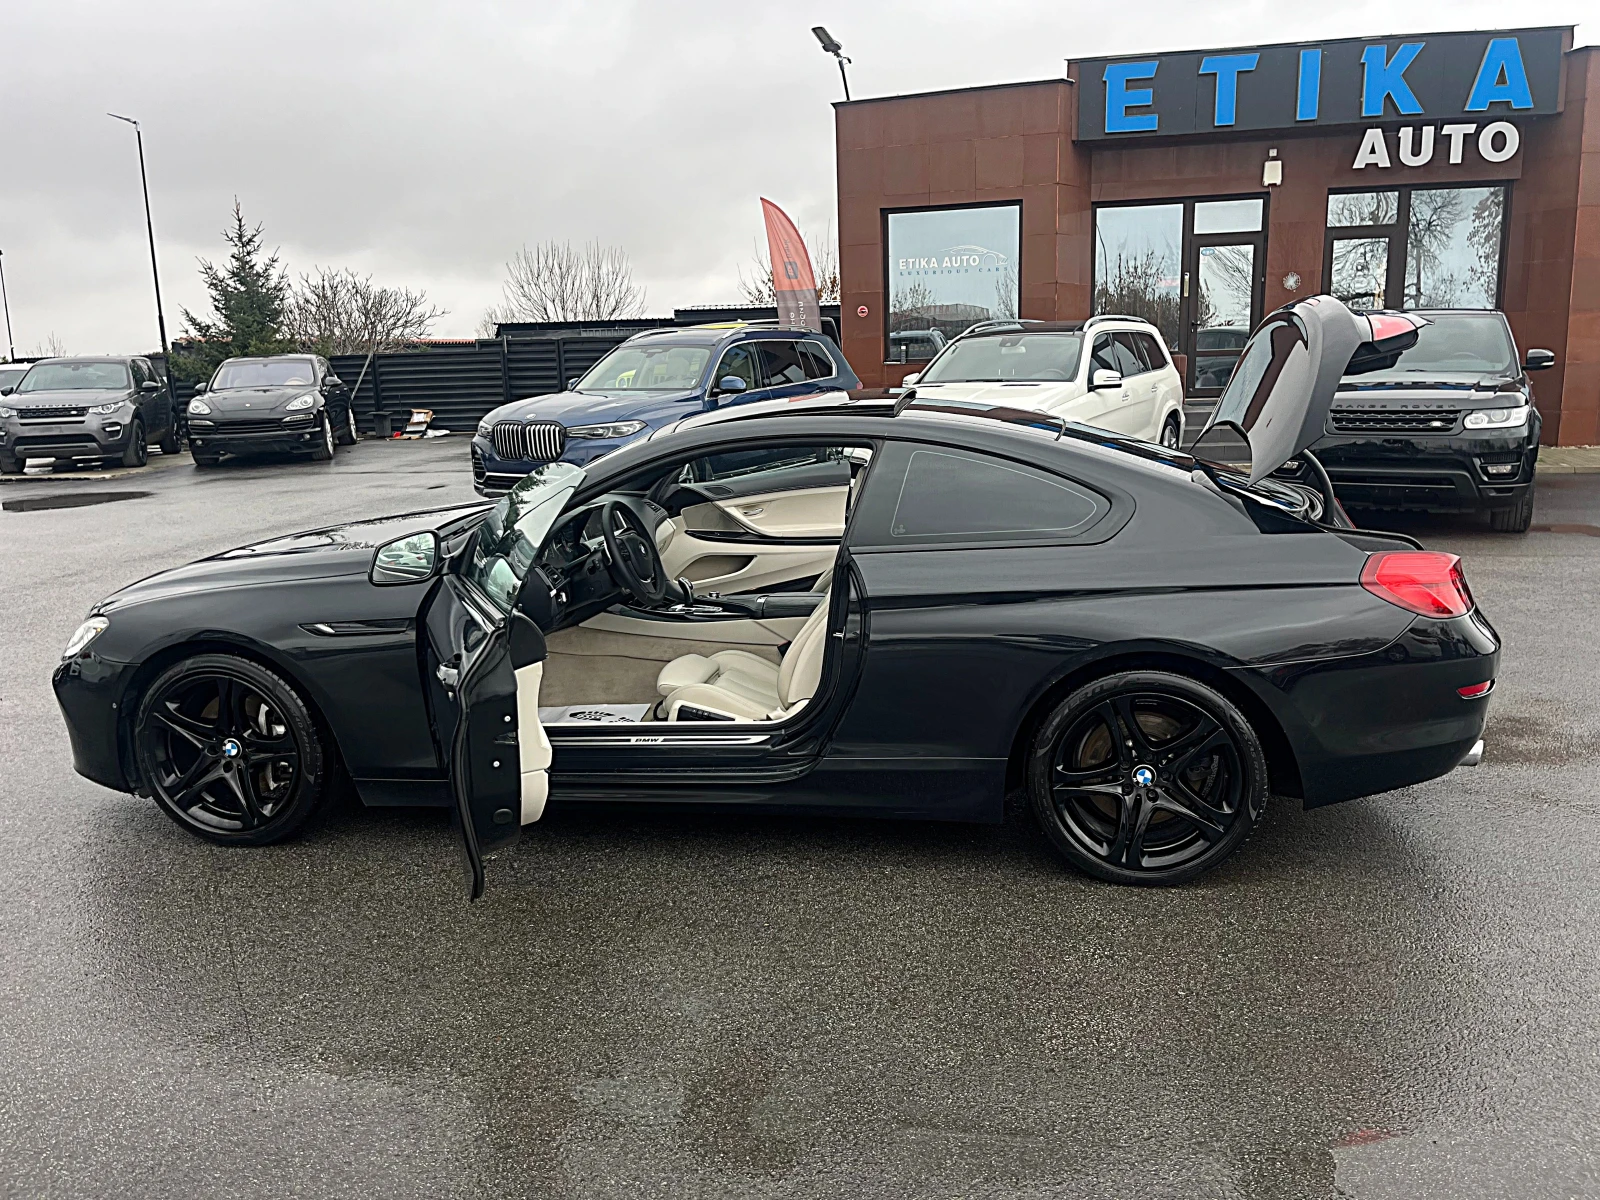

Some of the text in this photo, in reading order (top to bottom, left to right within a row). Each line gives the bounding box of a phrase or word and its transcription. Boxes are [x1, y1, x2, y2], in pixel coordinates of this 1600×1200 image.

[1102, 37, 1535, 134] ETIKA
[1352, 121, 1520, 170] AUTO
[899, 255, 980, 270] ETIKA AUTO
[900, 268, 969, 276] LUXURIOUS
